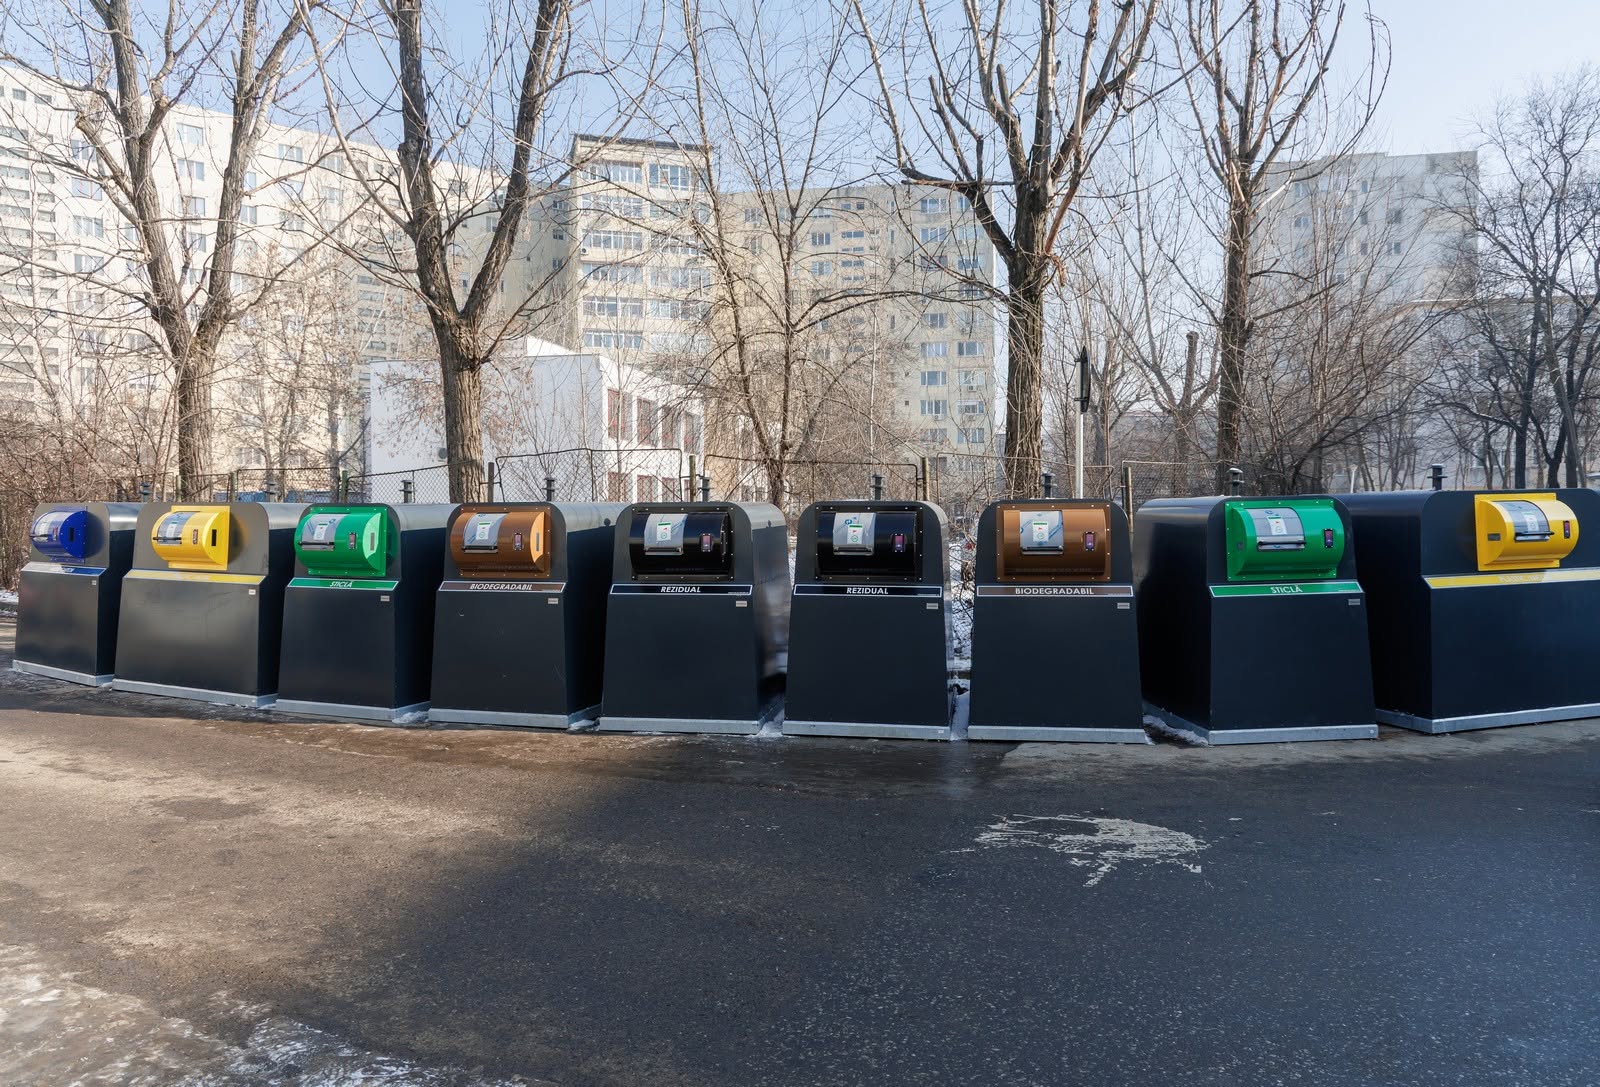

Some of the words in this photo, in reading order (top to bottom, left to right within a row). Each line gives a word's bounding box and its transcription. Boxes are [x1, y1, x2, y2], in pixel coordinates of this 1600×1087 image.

[470, 583, 533, 591] BIODEGRADABIL
[846, 587, 889, 595] REZIDUAL
[1015, 587, 1095, 595] BIODEGRADABIL
